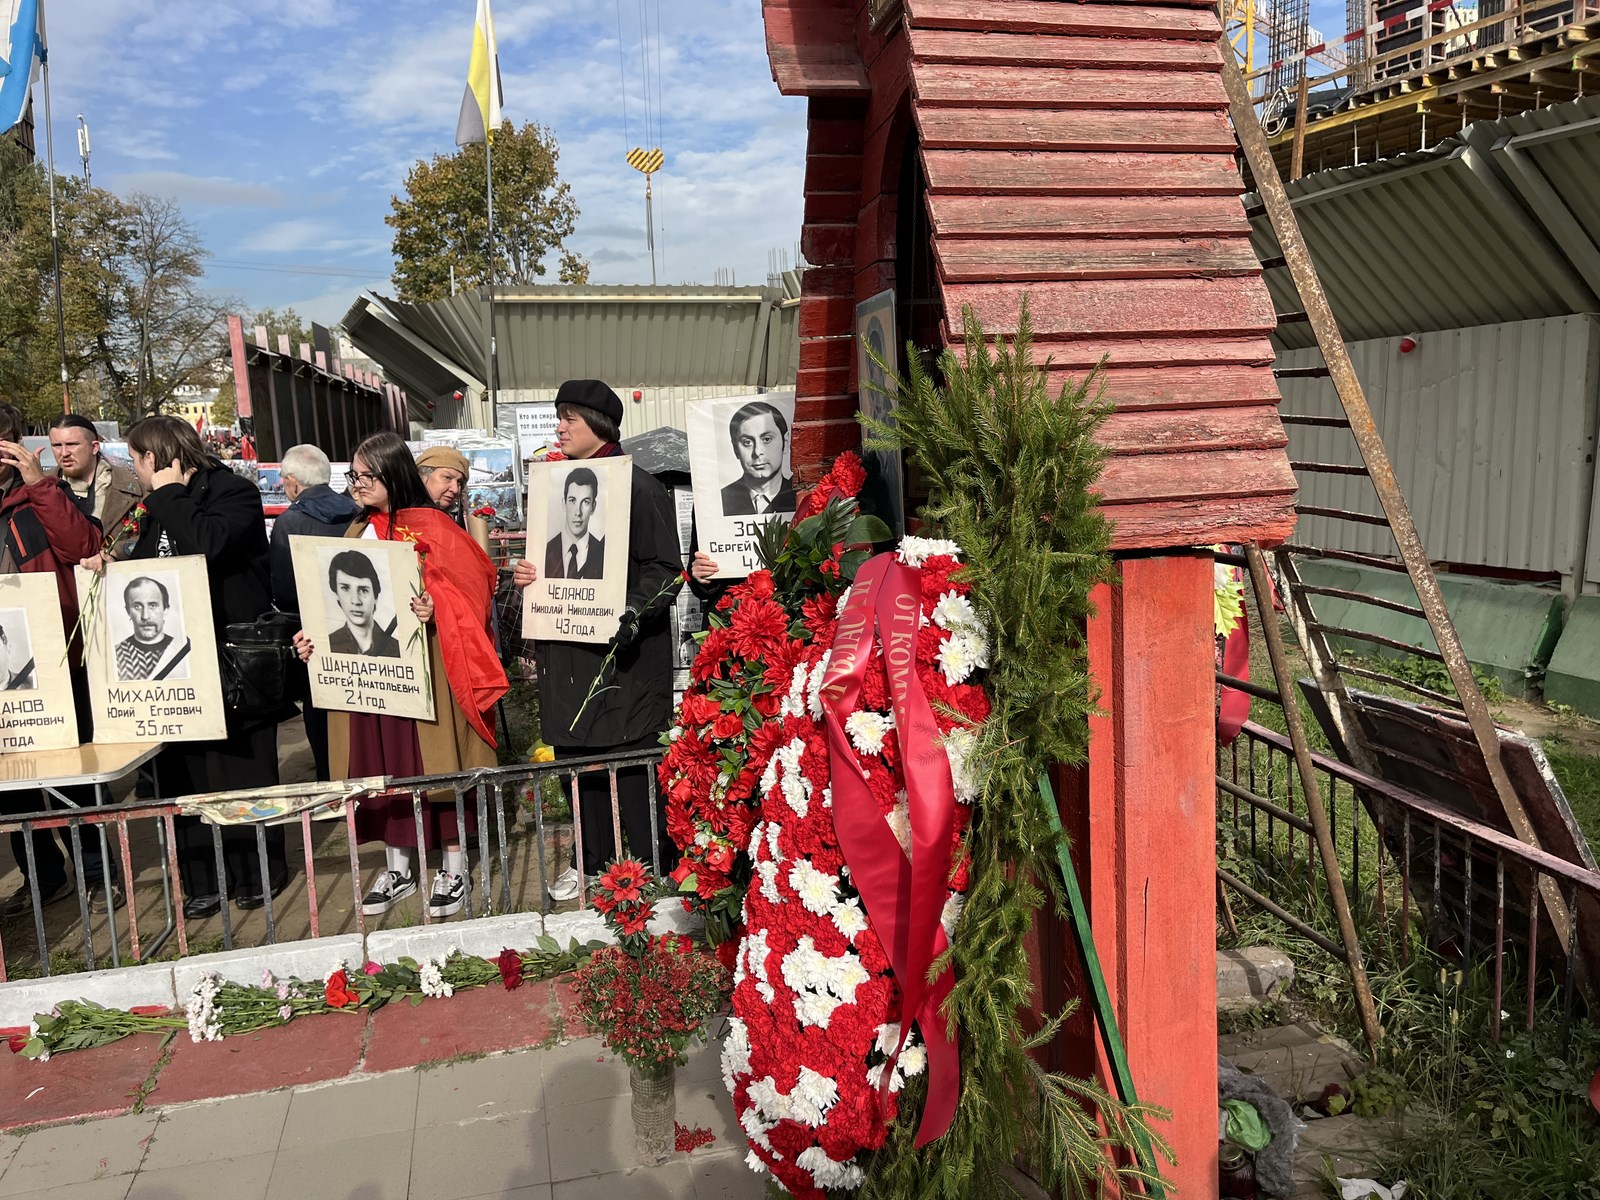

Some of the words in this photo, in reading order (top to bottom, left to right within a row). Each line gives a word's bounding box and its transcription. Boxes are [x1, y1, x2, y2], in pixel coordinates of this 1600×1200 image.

[893, 592, 917, 627] ОТ
[555, 617, 570, 635] 43
[344, 689, 363, 706] 21
[0, 699, 44, 715] АНОВ
[135, 719, 158, 737] 35
